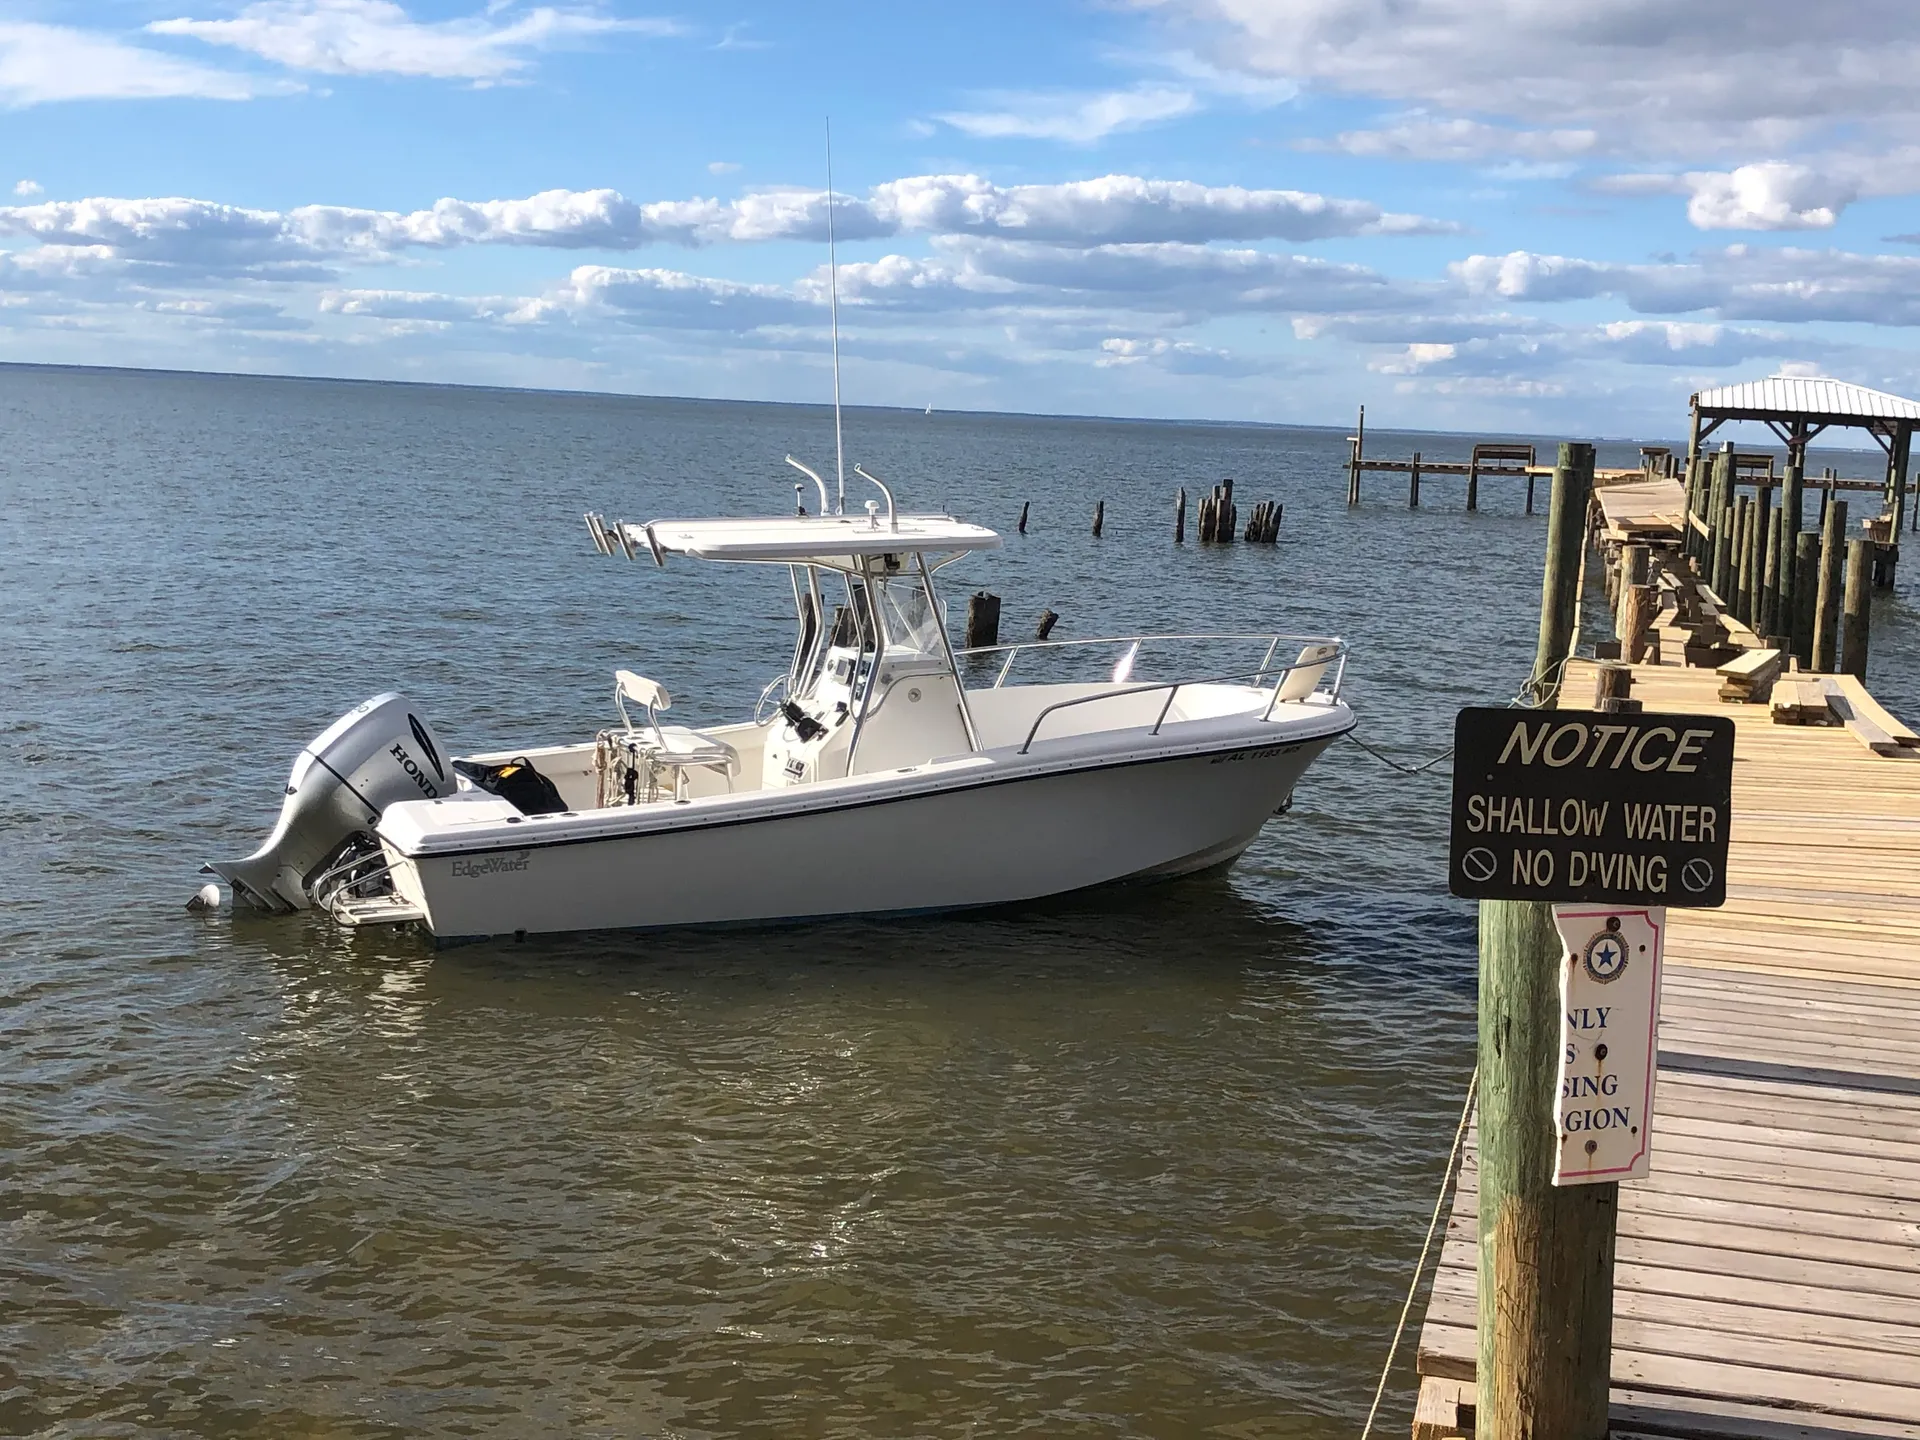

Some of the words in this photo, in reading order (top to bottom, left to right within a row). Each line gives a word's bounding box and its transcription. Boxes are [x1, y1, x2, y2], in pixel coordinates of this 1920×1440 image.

[1497, 721, 1714, 773] NOTICE
[389, 743, 438, 799] HOND
[1466, 794, 1609, 837] SHALLOW
[1624, 802, 1716, 843] WATER
[451, 856, 530, 878] EdgeWater
[1512, 849, 1554, 887] NO
[1562, 1106, 1630, 1132] GION
